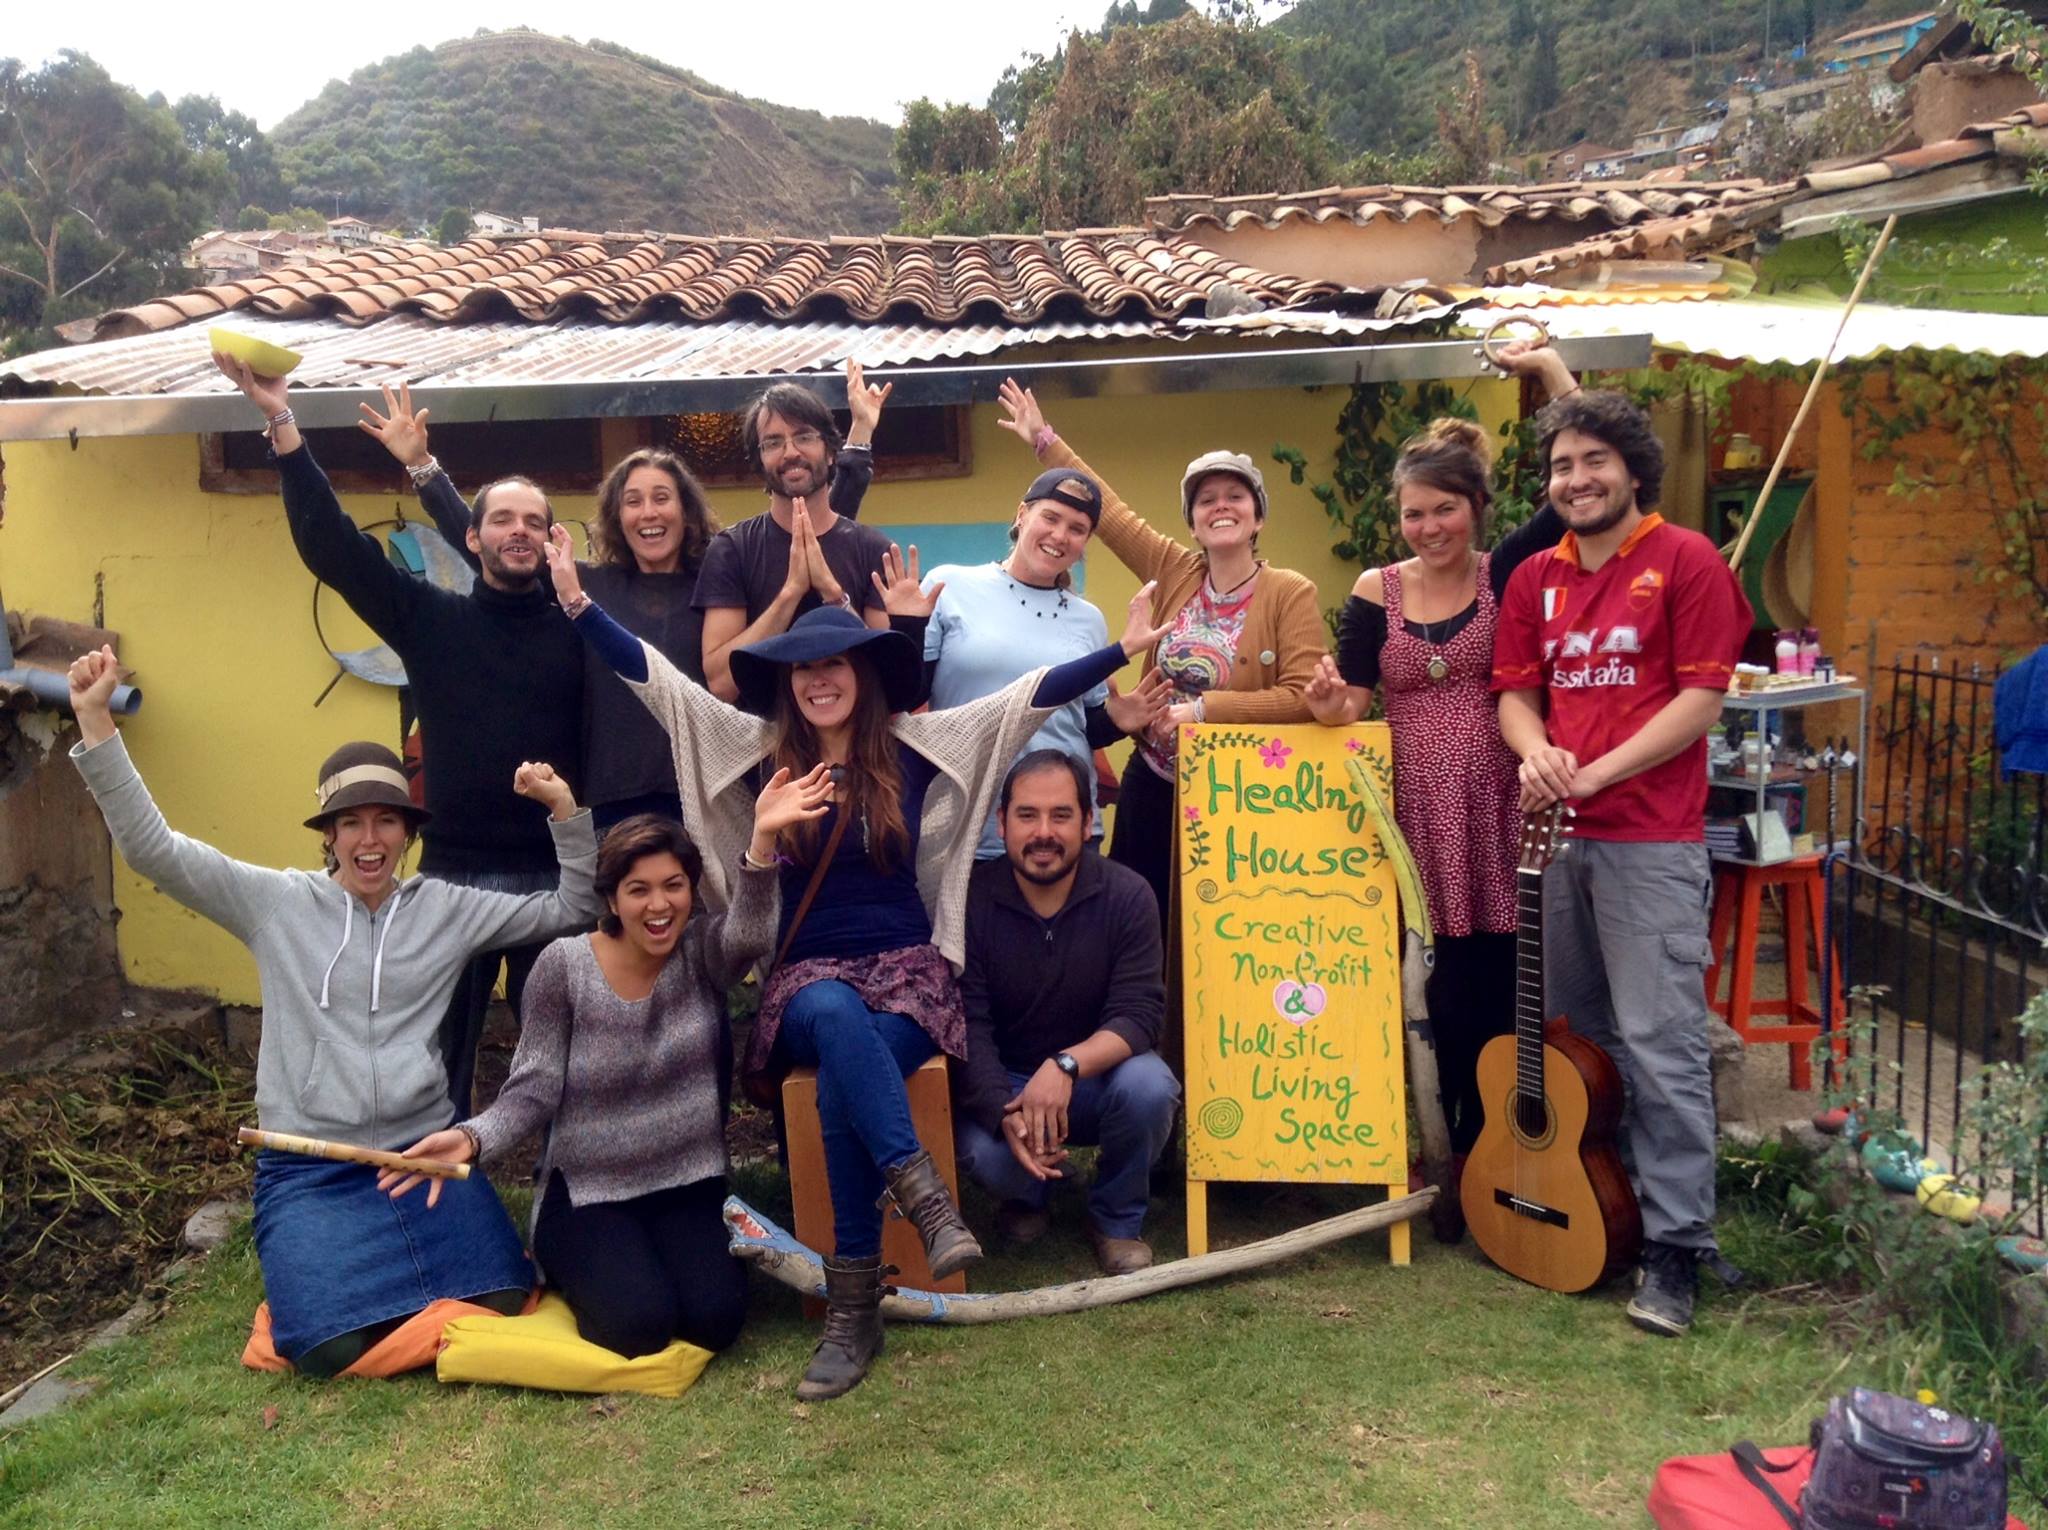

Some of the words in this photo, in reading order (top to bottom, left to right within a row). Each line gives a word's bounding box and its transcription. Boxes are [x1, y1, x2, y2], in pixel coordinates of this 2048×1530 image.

[1208, 755, 1366, 833] Healing
[1226, 825, 1369, 882] House
[1215, 912, 1368, 946] Creative
[1231, 952, 1372, 987] Non-Profit
[1284, 989, 1315, 1016] &
[1219, 1014, 1343, 1059] Holistic
[1252, 1064, 1359, 1121] Living
[1275, 1108, 1379, 1151] Space
